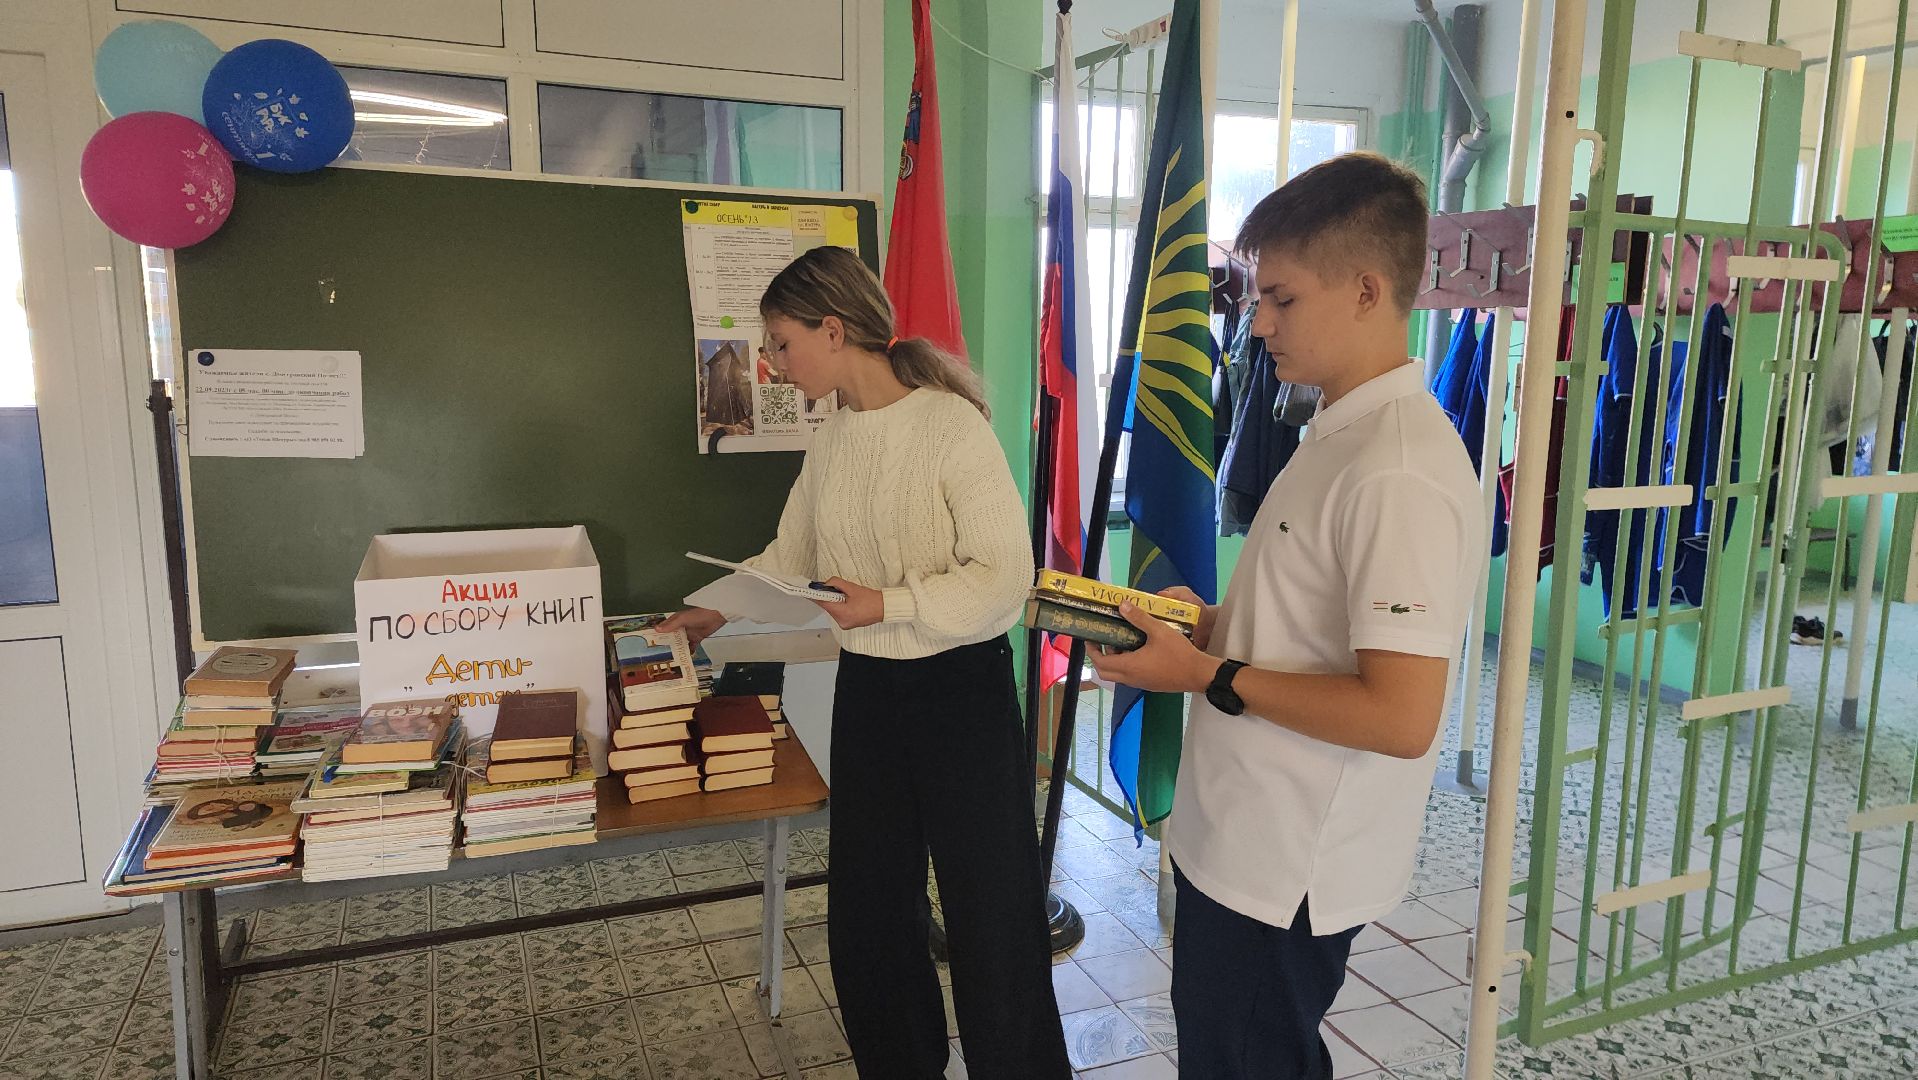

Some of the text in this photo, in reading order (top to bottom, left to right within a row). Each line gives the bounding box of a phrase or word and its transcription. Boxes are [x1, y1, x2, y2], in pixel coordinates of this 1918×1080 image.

[442, 579, 519, 603] Акция
[369, 595, 594, 643] ПО СБОРУ КНИГ
